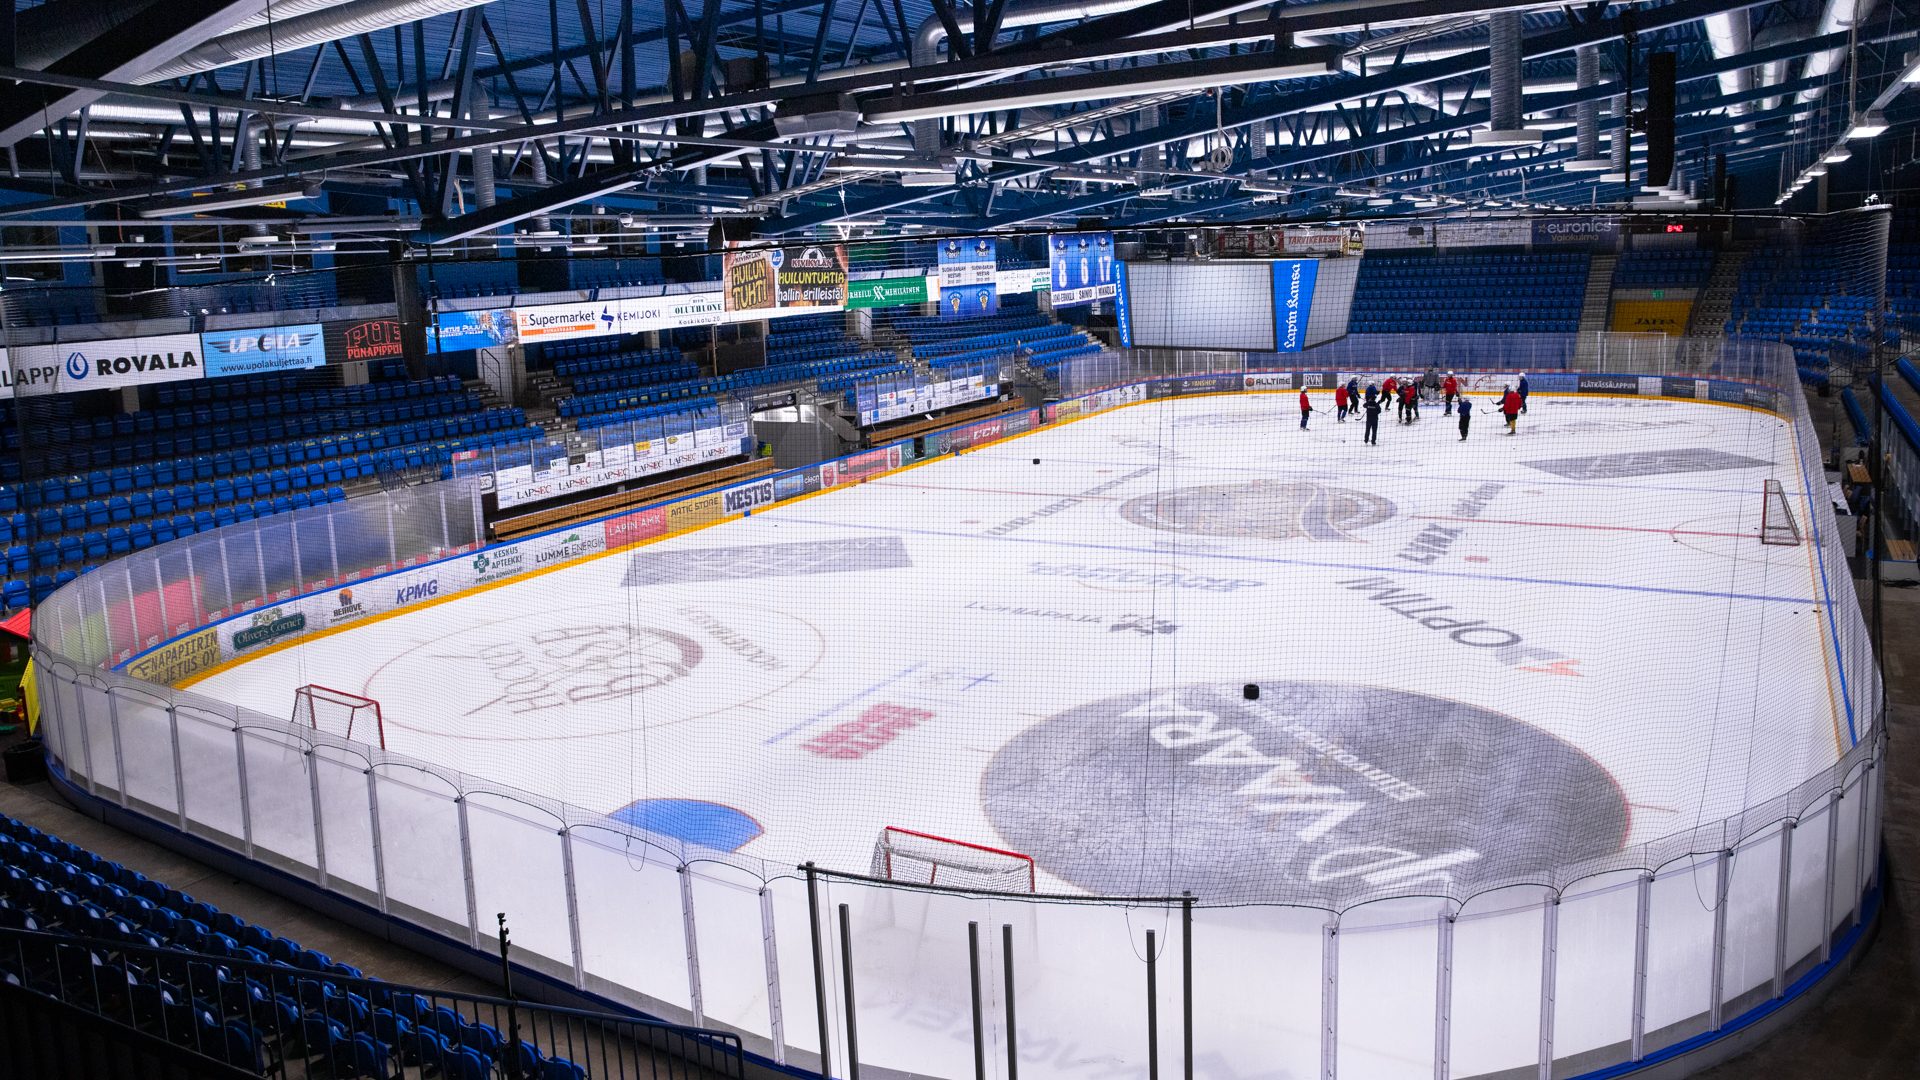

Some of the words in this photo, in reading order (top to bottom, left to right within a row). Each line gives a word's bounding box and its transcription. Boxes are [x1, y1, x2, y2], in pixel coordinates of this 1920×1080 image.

[1547, 221, 1611, 233] euronics
[732, 259, 766, 285] HUILUN
[1058, 259, 1068, 288] 8
[1080, 257, 1089, 285] 6
[1098, 255, 1111, 282] 17
[778, 271, 845, 285] HUILUNTUHTIA
[1285, 263, 1302, 308] Kansa
[732, 278, 768, 309] TUHTI
[778, 288, 800, 301] hallin
[803, 286, 844, 301] grilleistä!
[529, 310, 596, 327] Supermarket
[617, 308, 661, 321] KEMIJOKI
[1283, 309, 1297, 349] Lapin
[96, 351, 197, 376] ROVALA
[220, 356, 313, 374] www.upolakuljettaa.fi
[1256, 377, 1291, 385] ALLTIME
[1305, 375, 1321, 386] RVN
[973, 425, 1001, 440] CCM
[669, 452, 697, 465] LAPSEC
[701, 445, 729, 458] LAPSEC
[597, 468, 630, 481] LAPSEC
[634, 460, 664, 473] LAPSEC
[517, 484, 552, 500] LAPSEC
[558, 476, 592, 491] LAPSEC
[725, 482, 772, 512] MESTIS
[671, 504, 693, 517] ARTIC
[695, 497, 719, 511] STORE
[609, 520, 638, 536] LAPIN
[641, 514, 661, 528] AMK
[493, 546, 519, 559] KESKUS
[536, 546, 570, 563] LUMME
[571, 537, 605, 554] ENERGIA
[491, 555, 523, 569] APTEEKKI
[397, 579, 438, 605] KPMG
[237, 627, 268, 645] Oliver's
[270, 616, 302, 634] Corner
[151, 630, 218, 672] NAPAPIIRIN
[202, 648, 217, 666] OY
